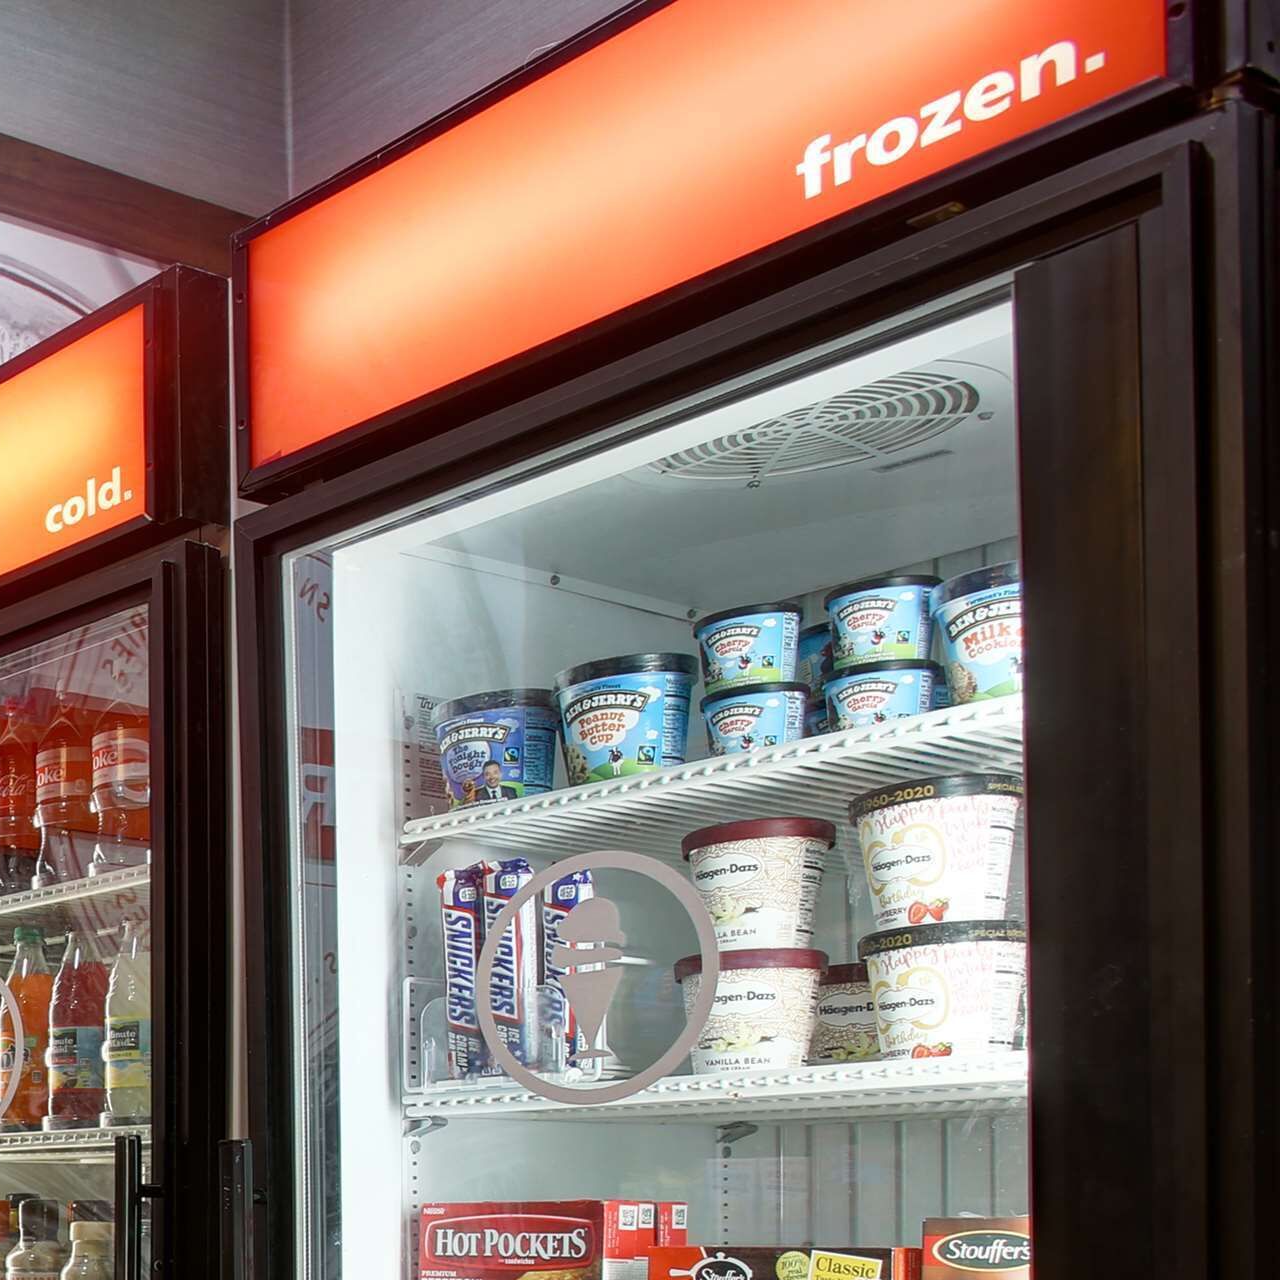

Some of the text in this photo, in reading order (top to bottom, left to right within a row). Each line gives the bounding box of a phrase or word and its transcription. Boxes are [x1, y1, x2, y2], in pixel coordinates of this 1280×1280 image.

[796, 40, 1105, 200] frozen.
[45, 466, 133, 533] cold.
[963, 622, 1011, 651] Milk
[968, 639, 1022, 659] Cookie
[578, 711, 625, 729] Peanut
[579, 722, 625, 740] Butter
[589, 733, 614, 745] Cup
[730, 928, 757, 938] BEAN
[444, 911, 477, 1029] SNICKERS
[819, 1001, 874, 1017] Häagen-D
[508, 1026, 521, 1045] ICE
[705, 1057, 740, 1067] VANILLA
[744, 1056, 771, 1064] BEAN
[946, 1239, 1030, 1264] Stouffer's
[816, 1256, 875, 1278] Classic
